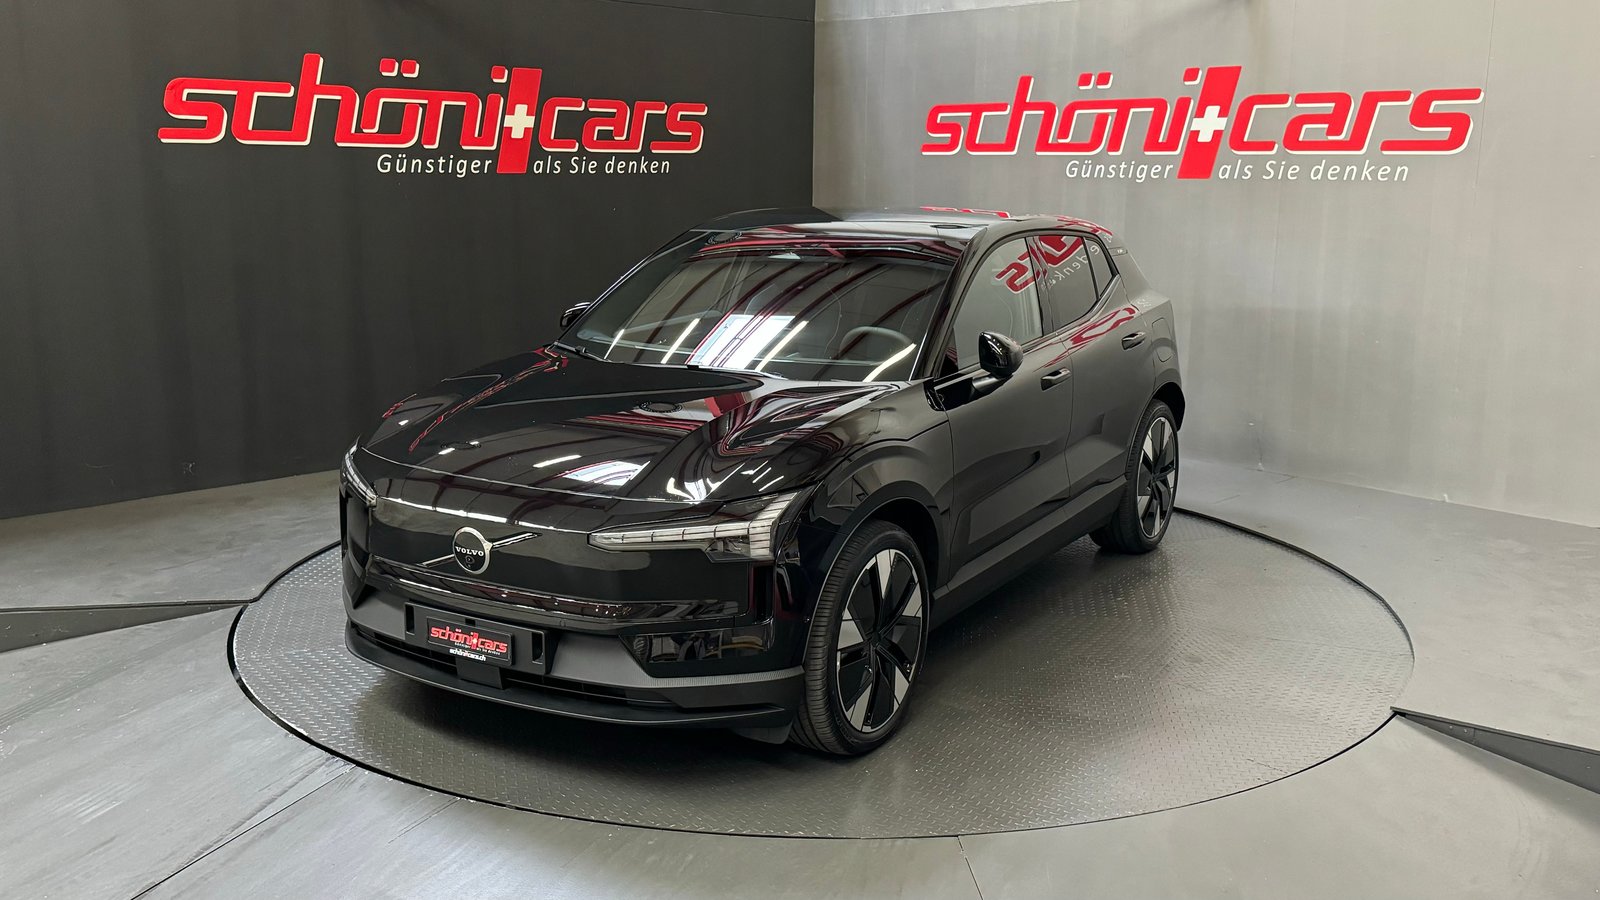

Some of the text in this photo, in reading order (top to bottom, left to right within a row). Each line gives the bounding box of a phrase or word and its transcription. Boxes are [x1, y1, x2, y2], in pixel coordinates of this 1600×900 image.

[376, 153, 671, 177] Günstiger als Sie denken
[1065, 159, 1409, 183] Günstiger als Sie denken
[455, 546, 484, 557] VOLVO
